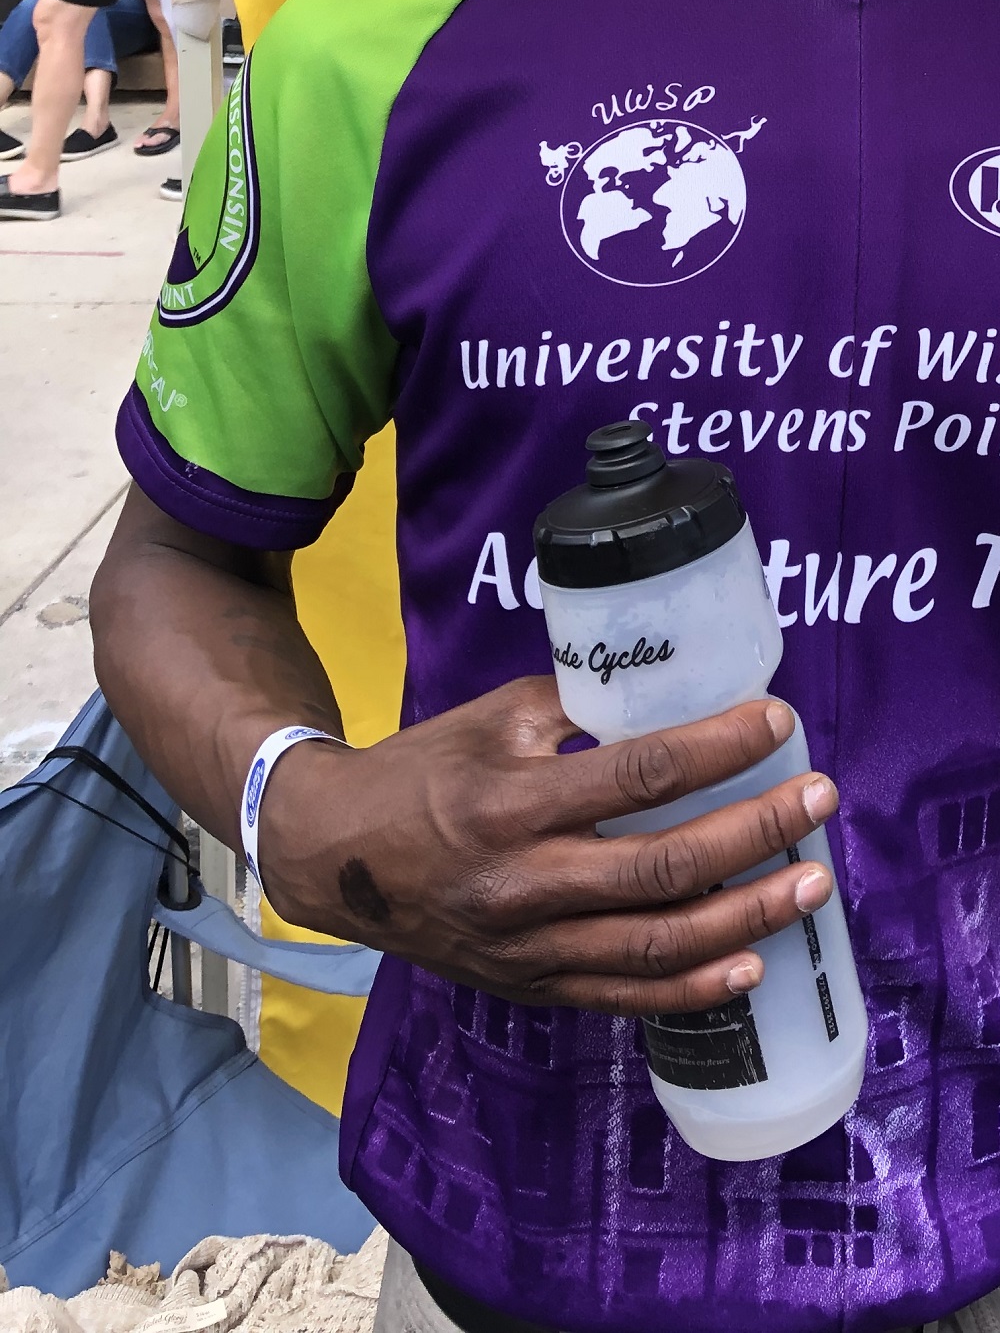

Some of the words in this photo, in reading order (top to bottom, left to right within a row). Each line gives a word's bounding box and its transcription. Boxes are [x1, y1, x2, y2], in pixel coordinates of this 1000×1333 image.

[591, 82, 717, 125] UWSP
[460, 319, 805, 390] University
[466, 532, 938, 628] Ature
[552, 641, 584, 670] ade
[588, 636, 676, 686] Cycles
